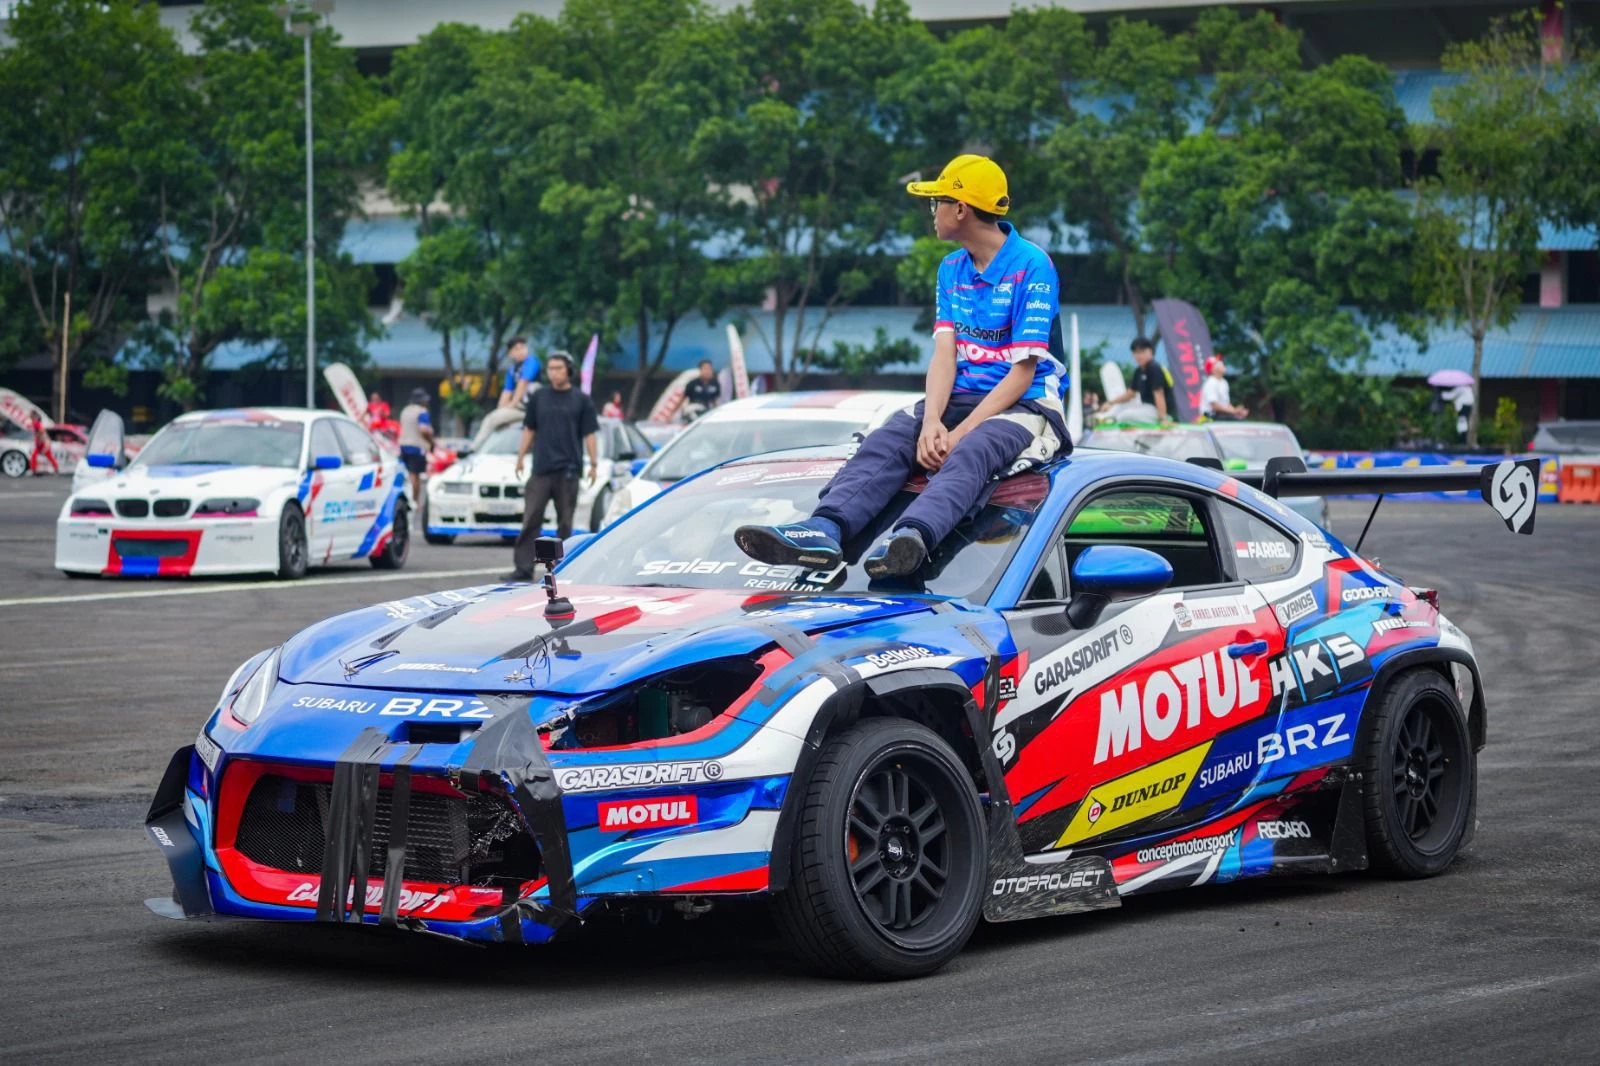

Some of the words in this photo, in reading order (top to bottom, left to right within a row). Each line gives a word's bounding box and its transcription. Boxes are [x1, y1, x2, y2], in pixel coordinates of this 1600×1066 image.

[1247, 541, 1291, 558] FARREL
[636, 558, 737, 575] Solar
[1283, 593, 1315, 621] VANOS
[865, 646, 934, 668] Belkote
[1270, 633, 1365, 697] HKS
[292, 696, 377, 715] SUBARU
[378, 697, 495, 719] BRZ
[1093, 645, 1260, 766] MOTUL
[1199, 751, 1253, 789] SUBARU
[1257, 713, 1350, 764] BRZ
[1110, 773, 1187, 814] DUNLOP
[605, 800, 692, 826] MOTUL
[1257, 821, 1311, 840] RECARO
[1137, 828, 1238, 864] conceptmotorsport
[992, 869, 1104, 895] OTOPROJECT
